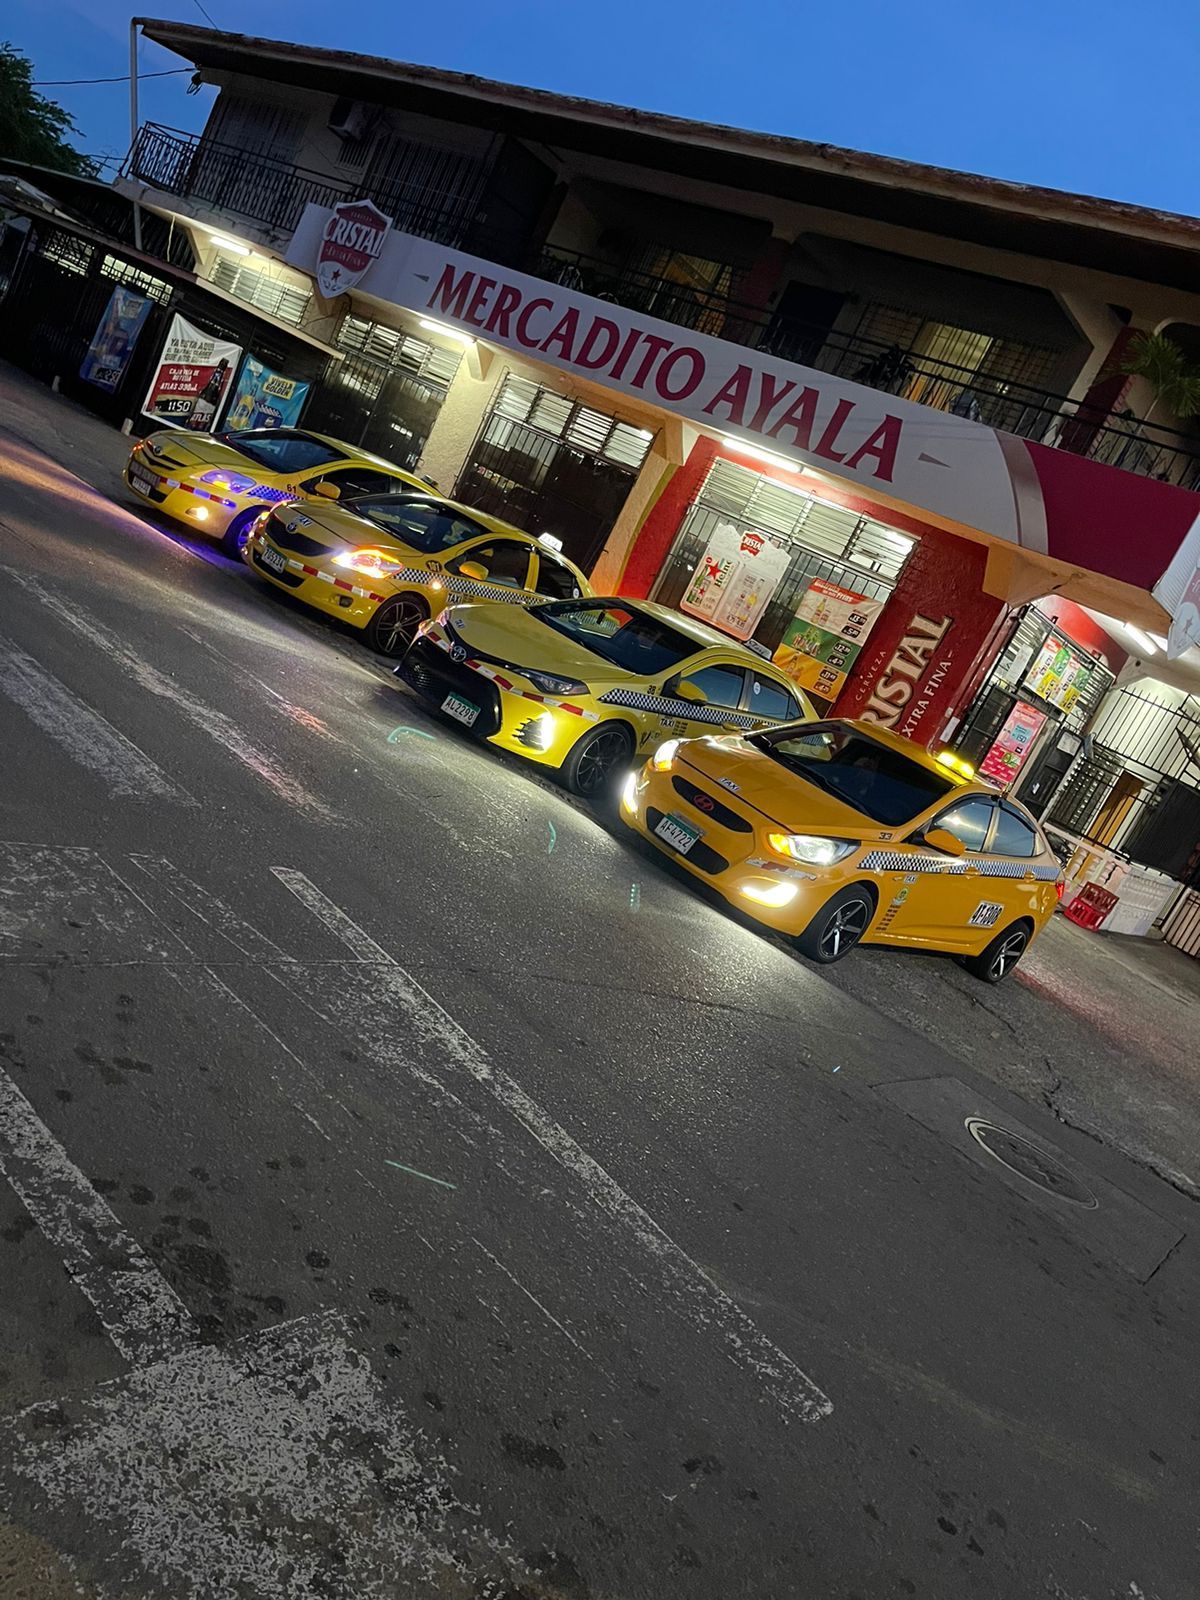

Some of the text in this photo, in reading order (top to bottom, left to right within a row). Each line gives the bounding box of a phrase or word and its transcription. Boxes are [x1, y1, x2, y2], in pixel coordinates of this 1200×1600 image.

[323, 215, 386, 258] CRISTAL
[426, 262, 904, 484] MERCADITO AYALA
[159, 382, 179, 391] ATLAS
[286, 483, 298, 494] 61
[447, 593, 463, 604] TAXI
[854, 649, 887, 702] CERVEZA
[859, 611, 954, 728] RISTAL
[445, 697, 476, 722] AL2298
[901, 659, 952, 738] XTRA FINA
[660, 718, 675, 729] TAXI
[720, 777, 740, 792] TAXI
[660, 820, 693, 849] AF4722
[878, 831, 893, 841] 33
